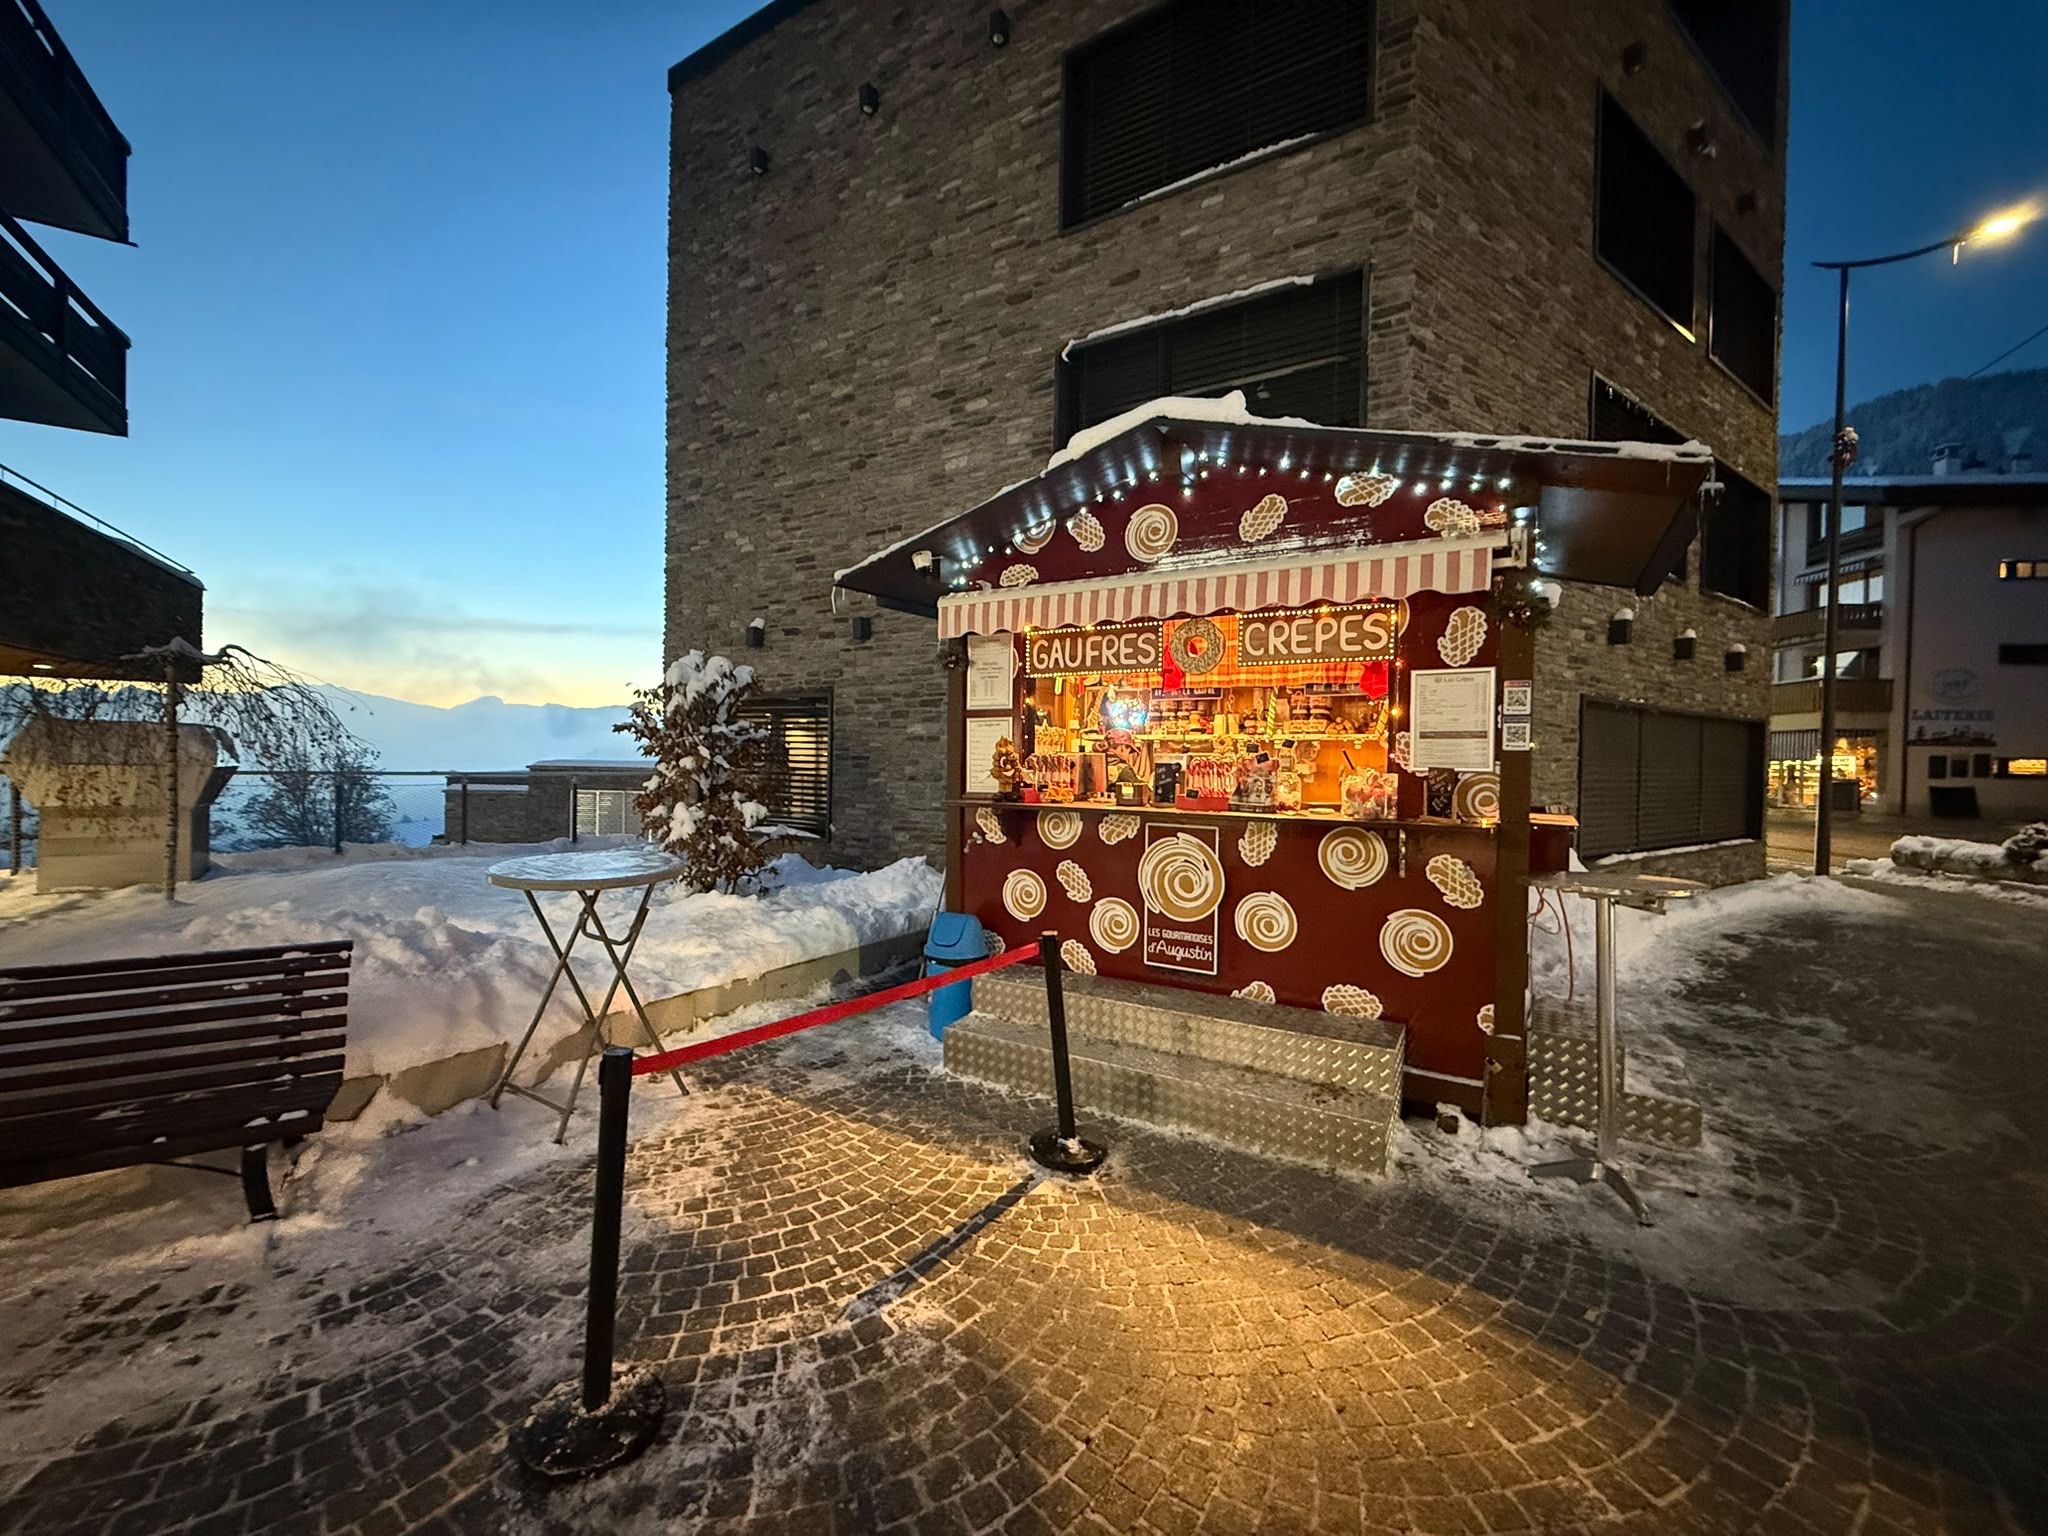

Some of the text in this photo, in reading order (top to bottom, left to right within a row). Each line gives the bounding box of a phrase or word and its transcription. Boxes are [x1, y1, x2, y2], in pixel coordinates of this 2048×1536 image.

[1032, 632, 1157, 670] GAUFRES
[1148, 927, 1213, 945] LES GOURMANDISES
[1148, 940, 1212, 961] d'Augustin
